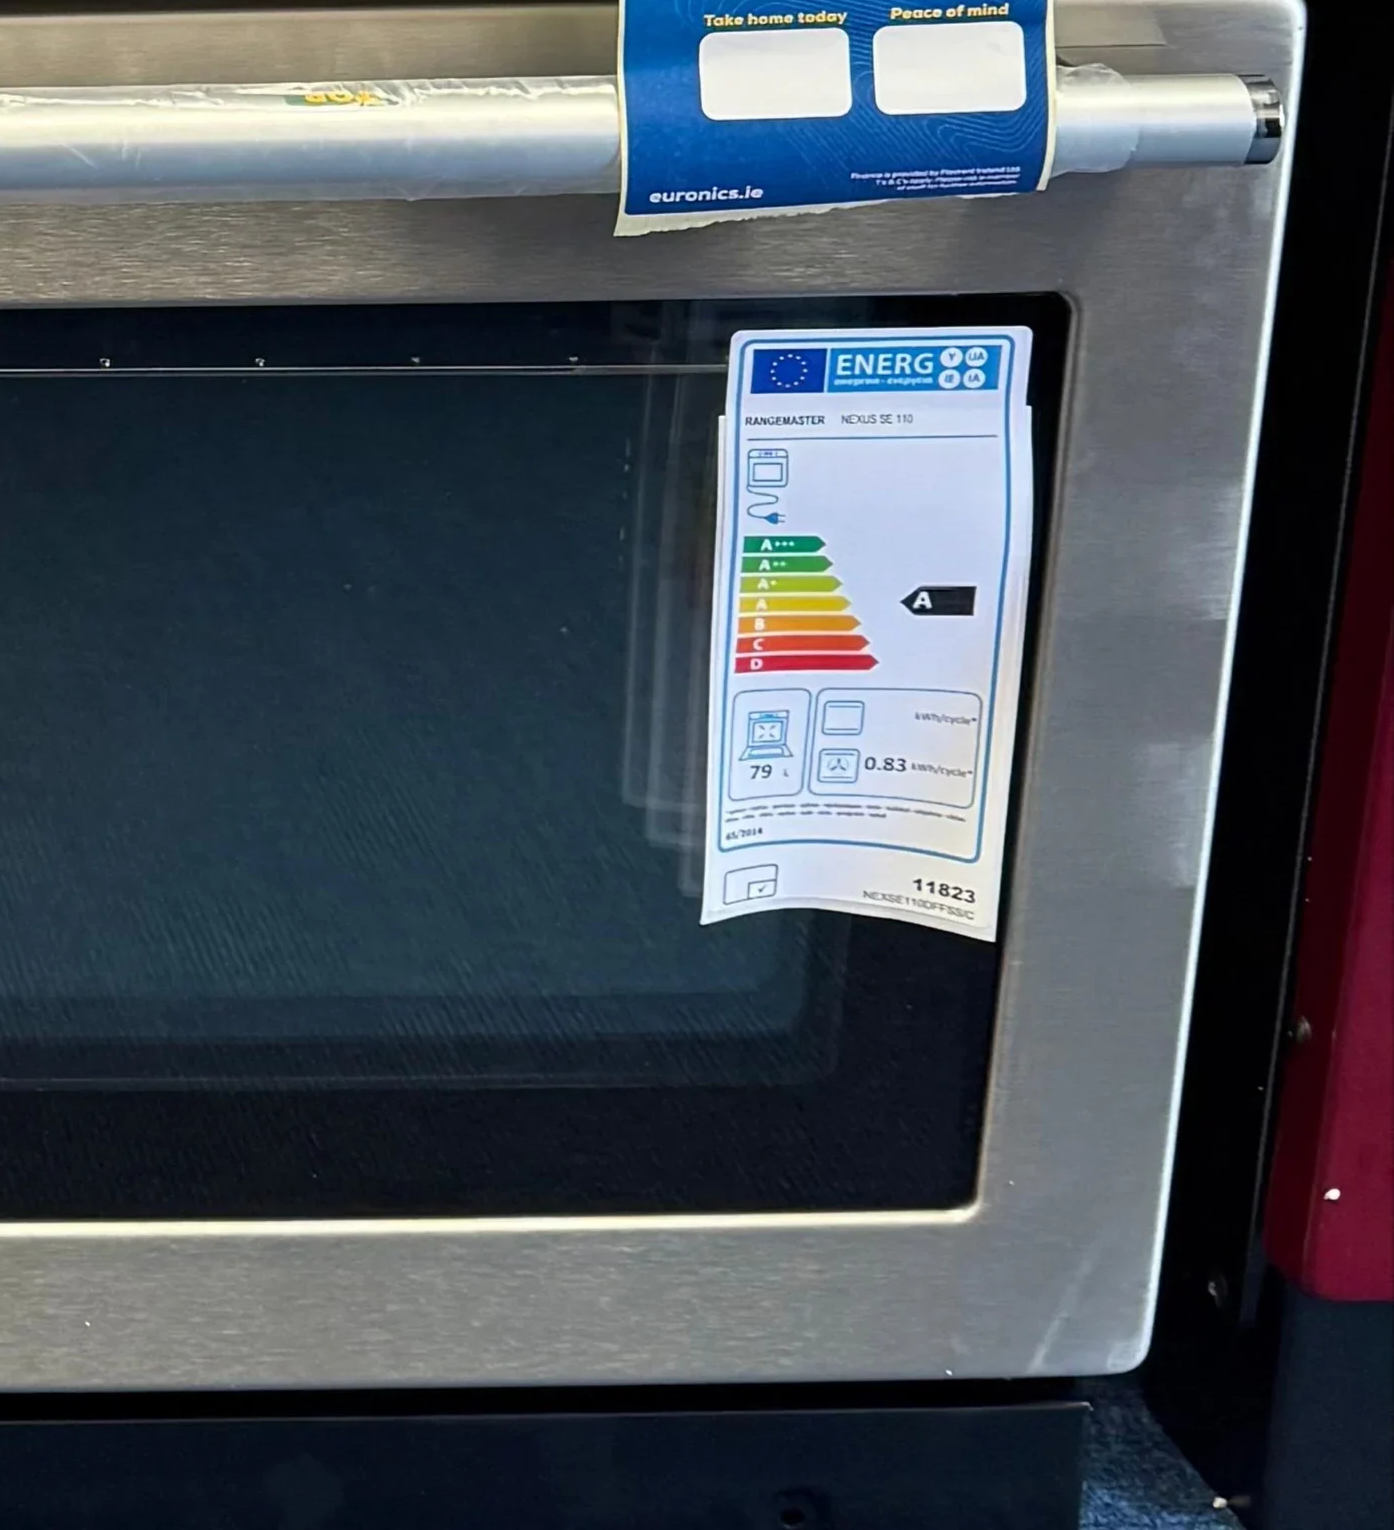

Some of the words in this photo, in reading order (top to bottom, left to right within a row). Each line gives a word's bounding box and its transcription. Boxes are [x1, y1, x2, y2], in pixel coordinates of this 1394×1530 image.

[704, 13, 744, 28] Take
[747, 12, 794, 26] home
[797, 10, 847, 26] today
[890, 6, 941, 21] Peace
[944, 5, 964, 19] of
[966, 3, 1009, 17] mind
[649, 186, 763, 204] euronics.ie
[837, 353, 934, 375] ENERG
[745, 415, 825, 427] RANGEMASTER
[841, 414, 877, 425] NEXUS
[879, 414, 893, 424] SE
[896, 413, 914, 424] 110
[756, 599, 768, 610] A
[912, 591, 932, 610] A
[754, 618, 765, 631] B
[753, 639, 764, 651] C
[750, 658, 763, 671] D
[749, 764, 772, 780] 79
[864, 756, 908, 772] 0.83
[913, 878, 976, 905] 11823
